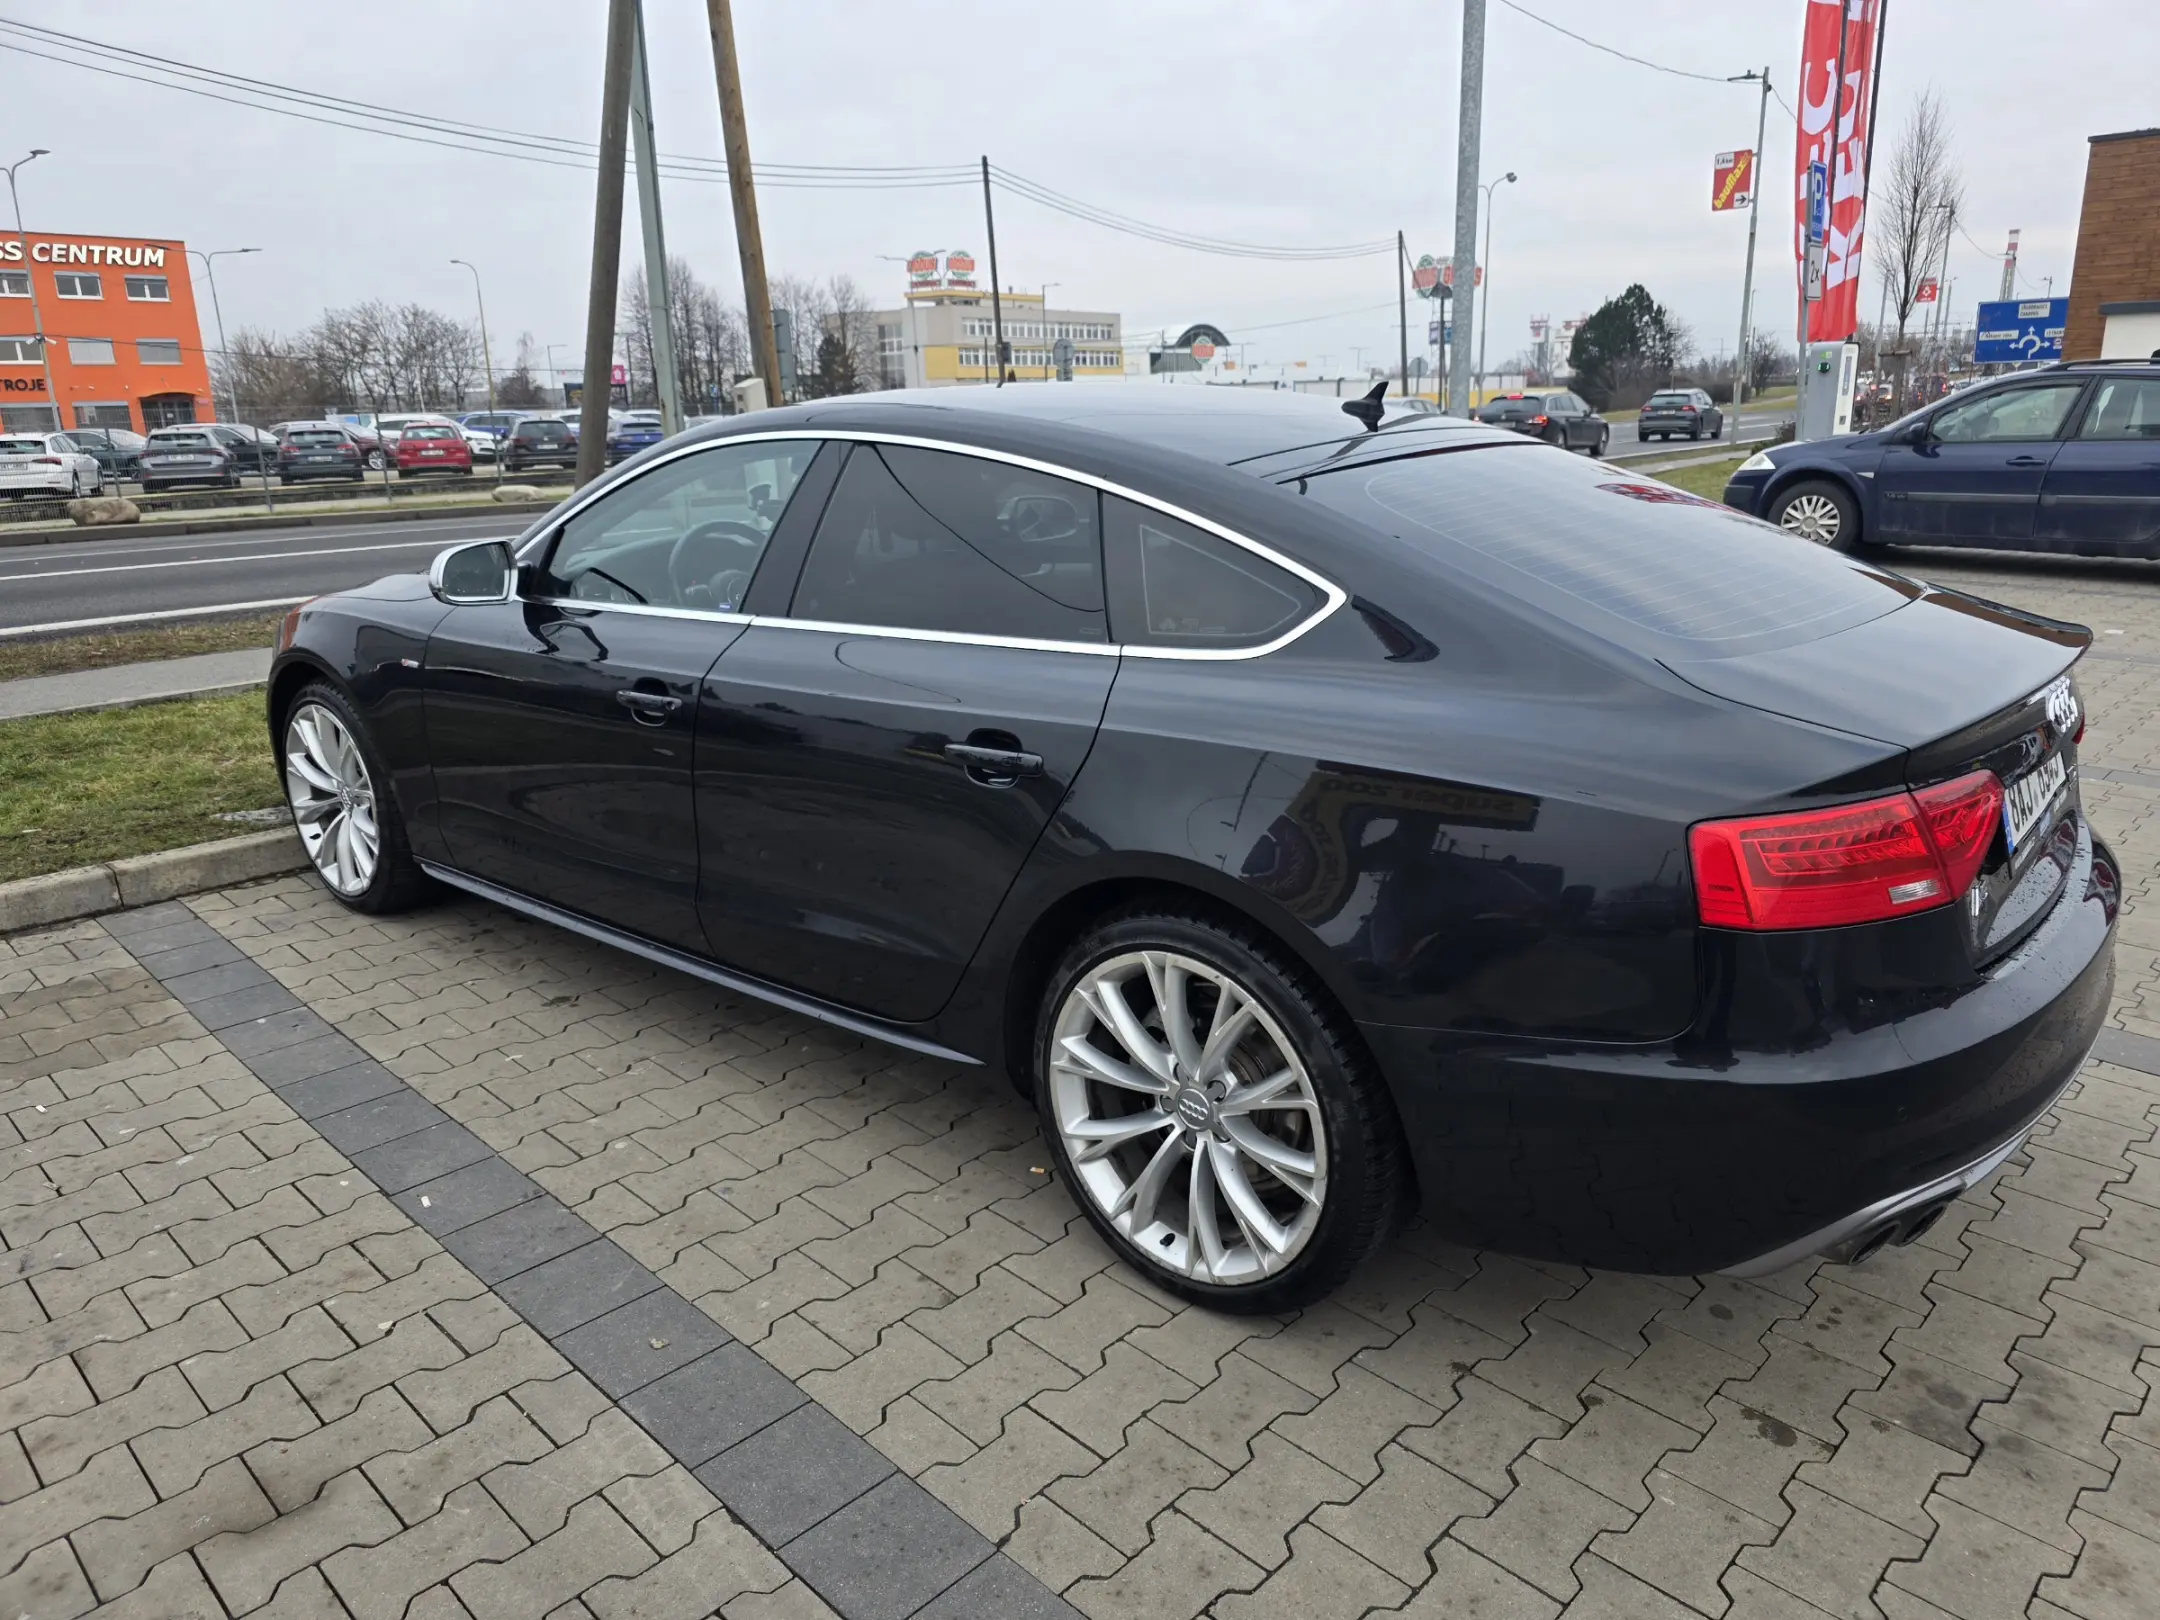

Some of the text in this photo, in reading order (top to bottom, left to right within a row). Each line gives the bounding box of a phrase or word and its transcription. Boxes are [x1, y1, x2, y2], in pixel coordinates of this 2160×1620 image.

[1814, 171, 1823, 215] P
[0, 241, 165, 268] S CENTRUM
[1809, 260, 1820, 284] 2x
